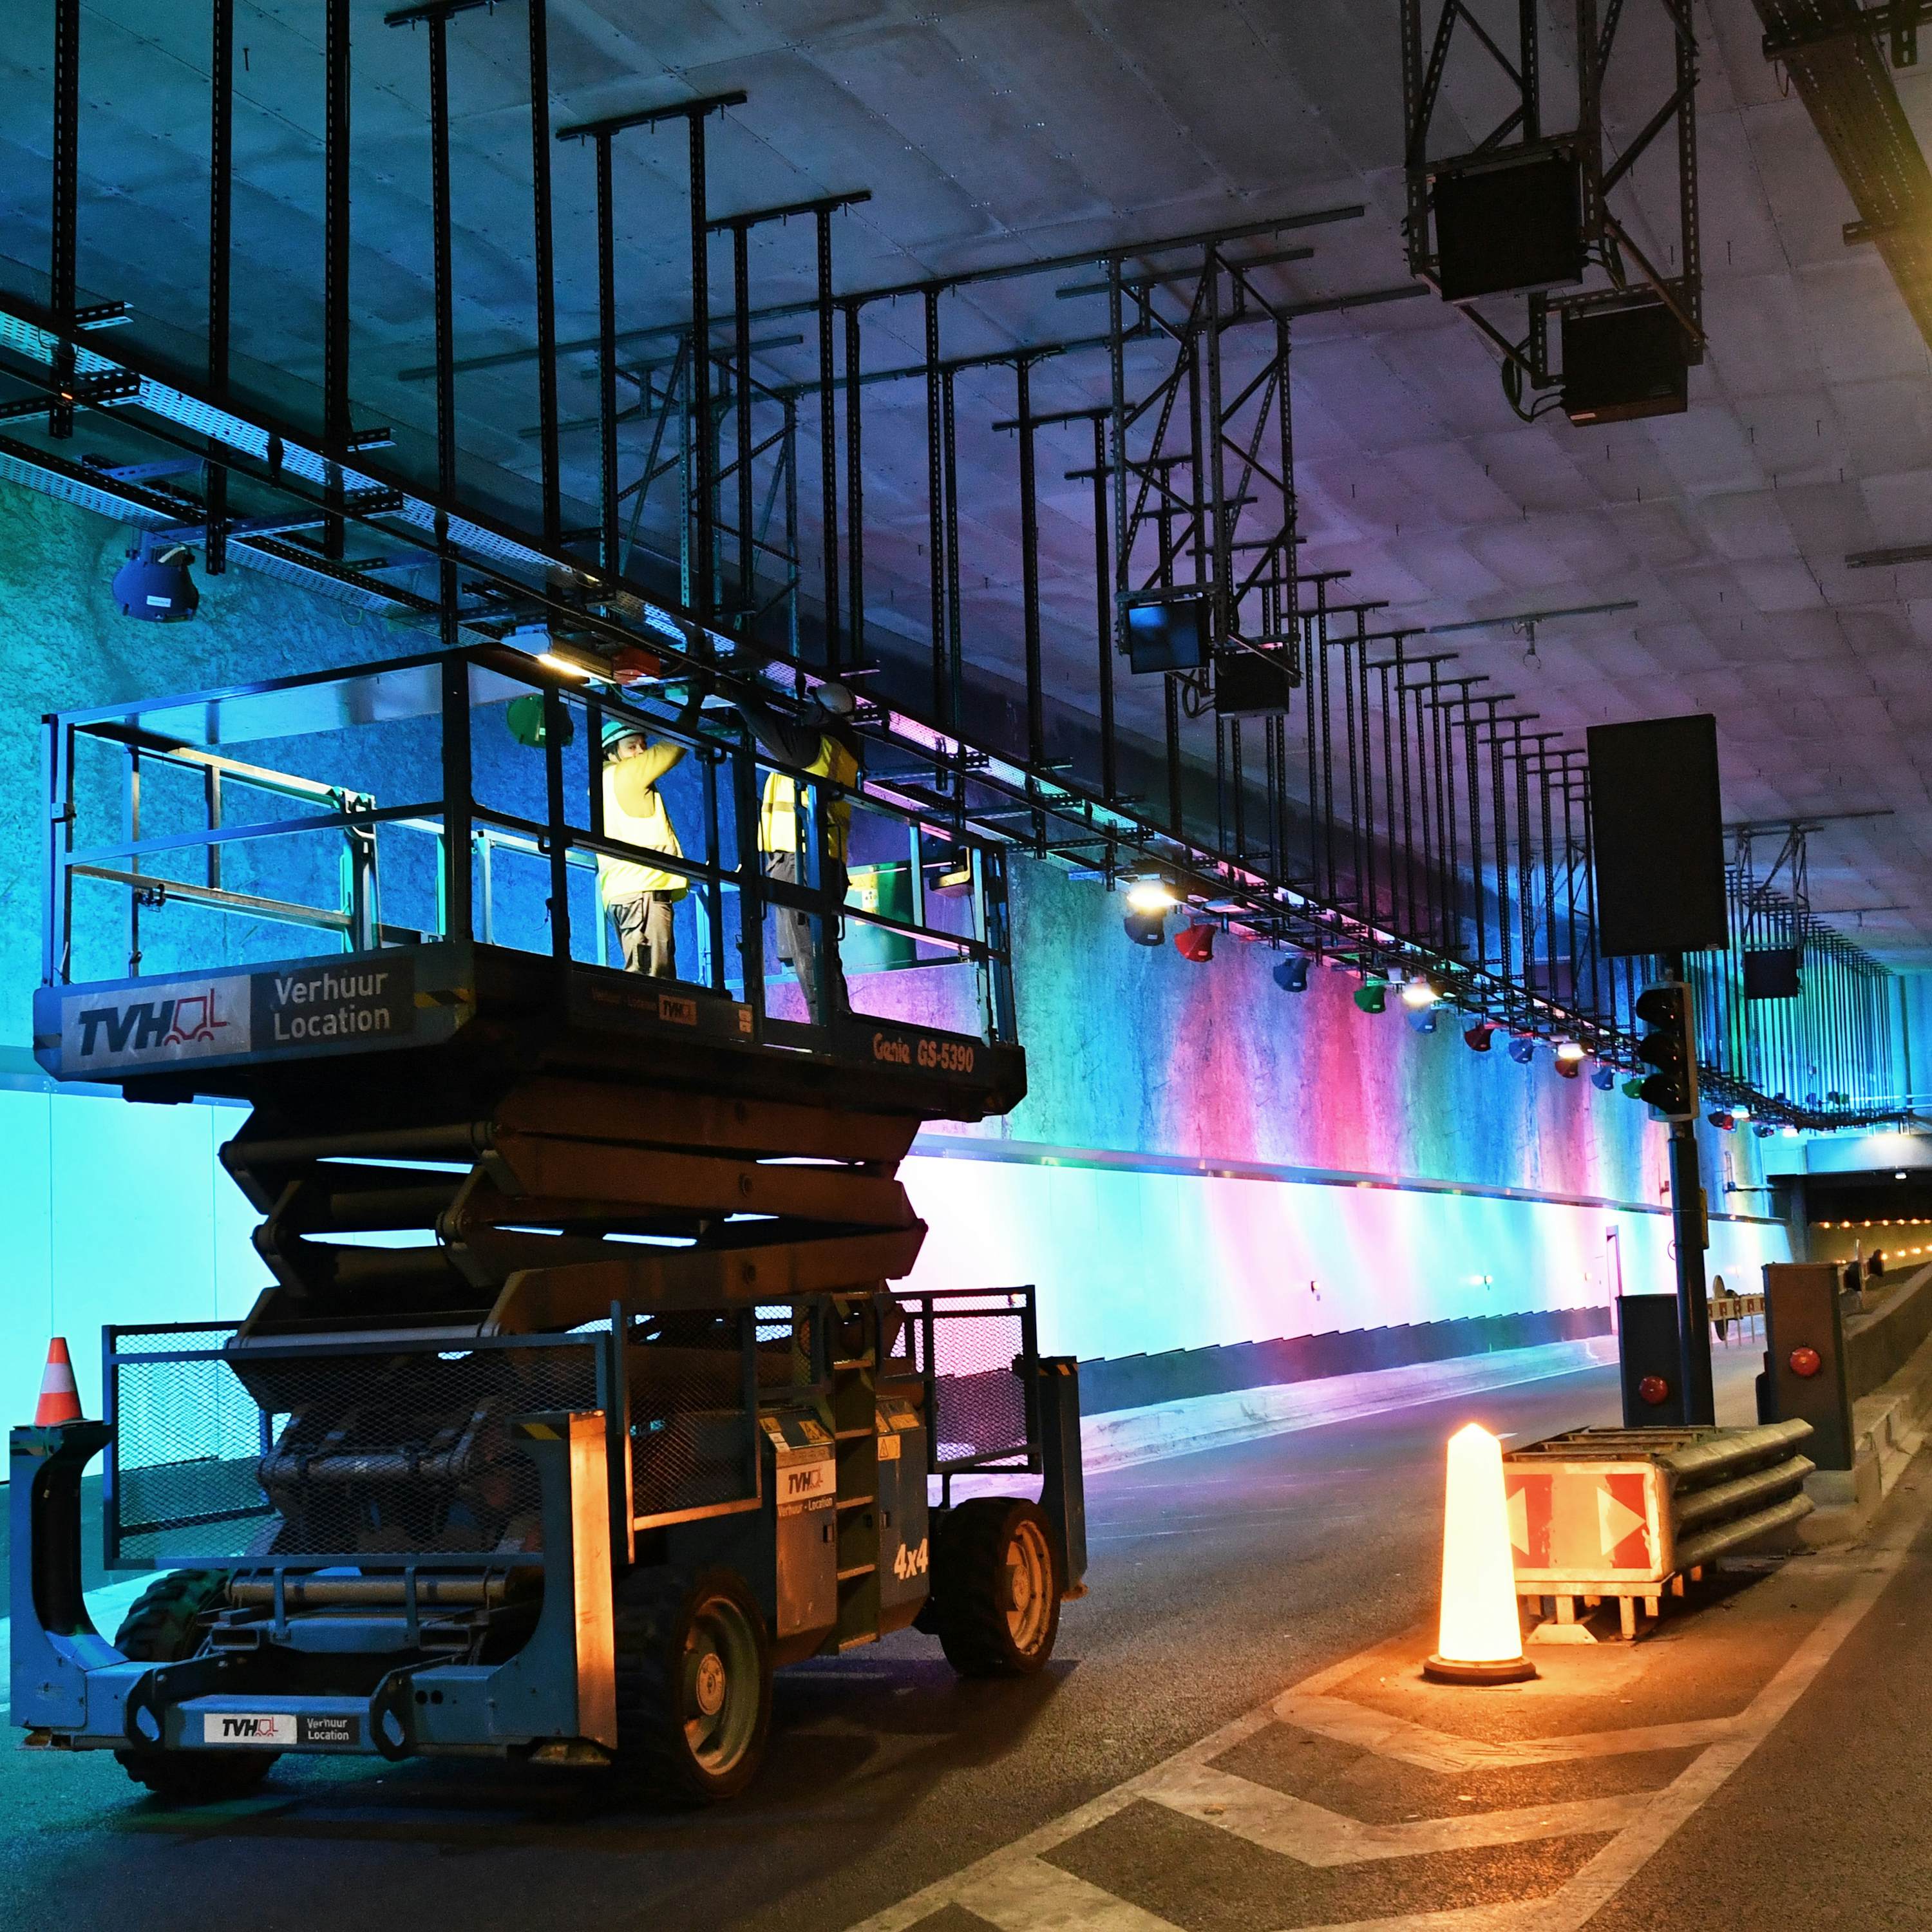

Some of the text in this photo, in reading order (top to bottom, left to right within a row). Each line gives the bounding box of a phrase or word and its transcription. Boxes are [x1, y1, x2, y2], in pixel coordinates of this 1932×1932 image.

[274, 968, 388, 1006] Verhuur
[79, 999, 175, 1056] TVH
[274, 1003, 390, 1041] Location
[873, 1032, 974, 1073] Genie GS-5390
[788, 1471, 811, 1495] TVH
[808, 1497, 833, 1511] Location
[894, 1538, 929, 1580] 4x4
[222, 1719, 258, 1736] TVH
[307, 1718, 347, 1729] Verhuur
[308, 1730, 349, 1741] Location
